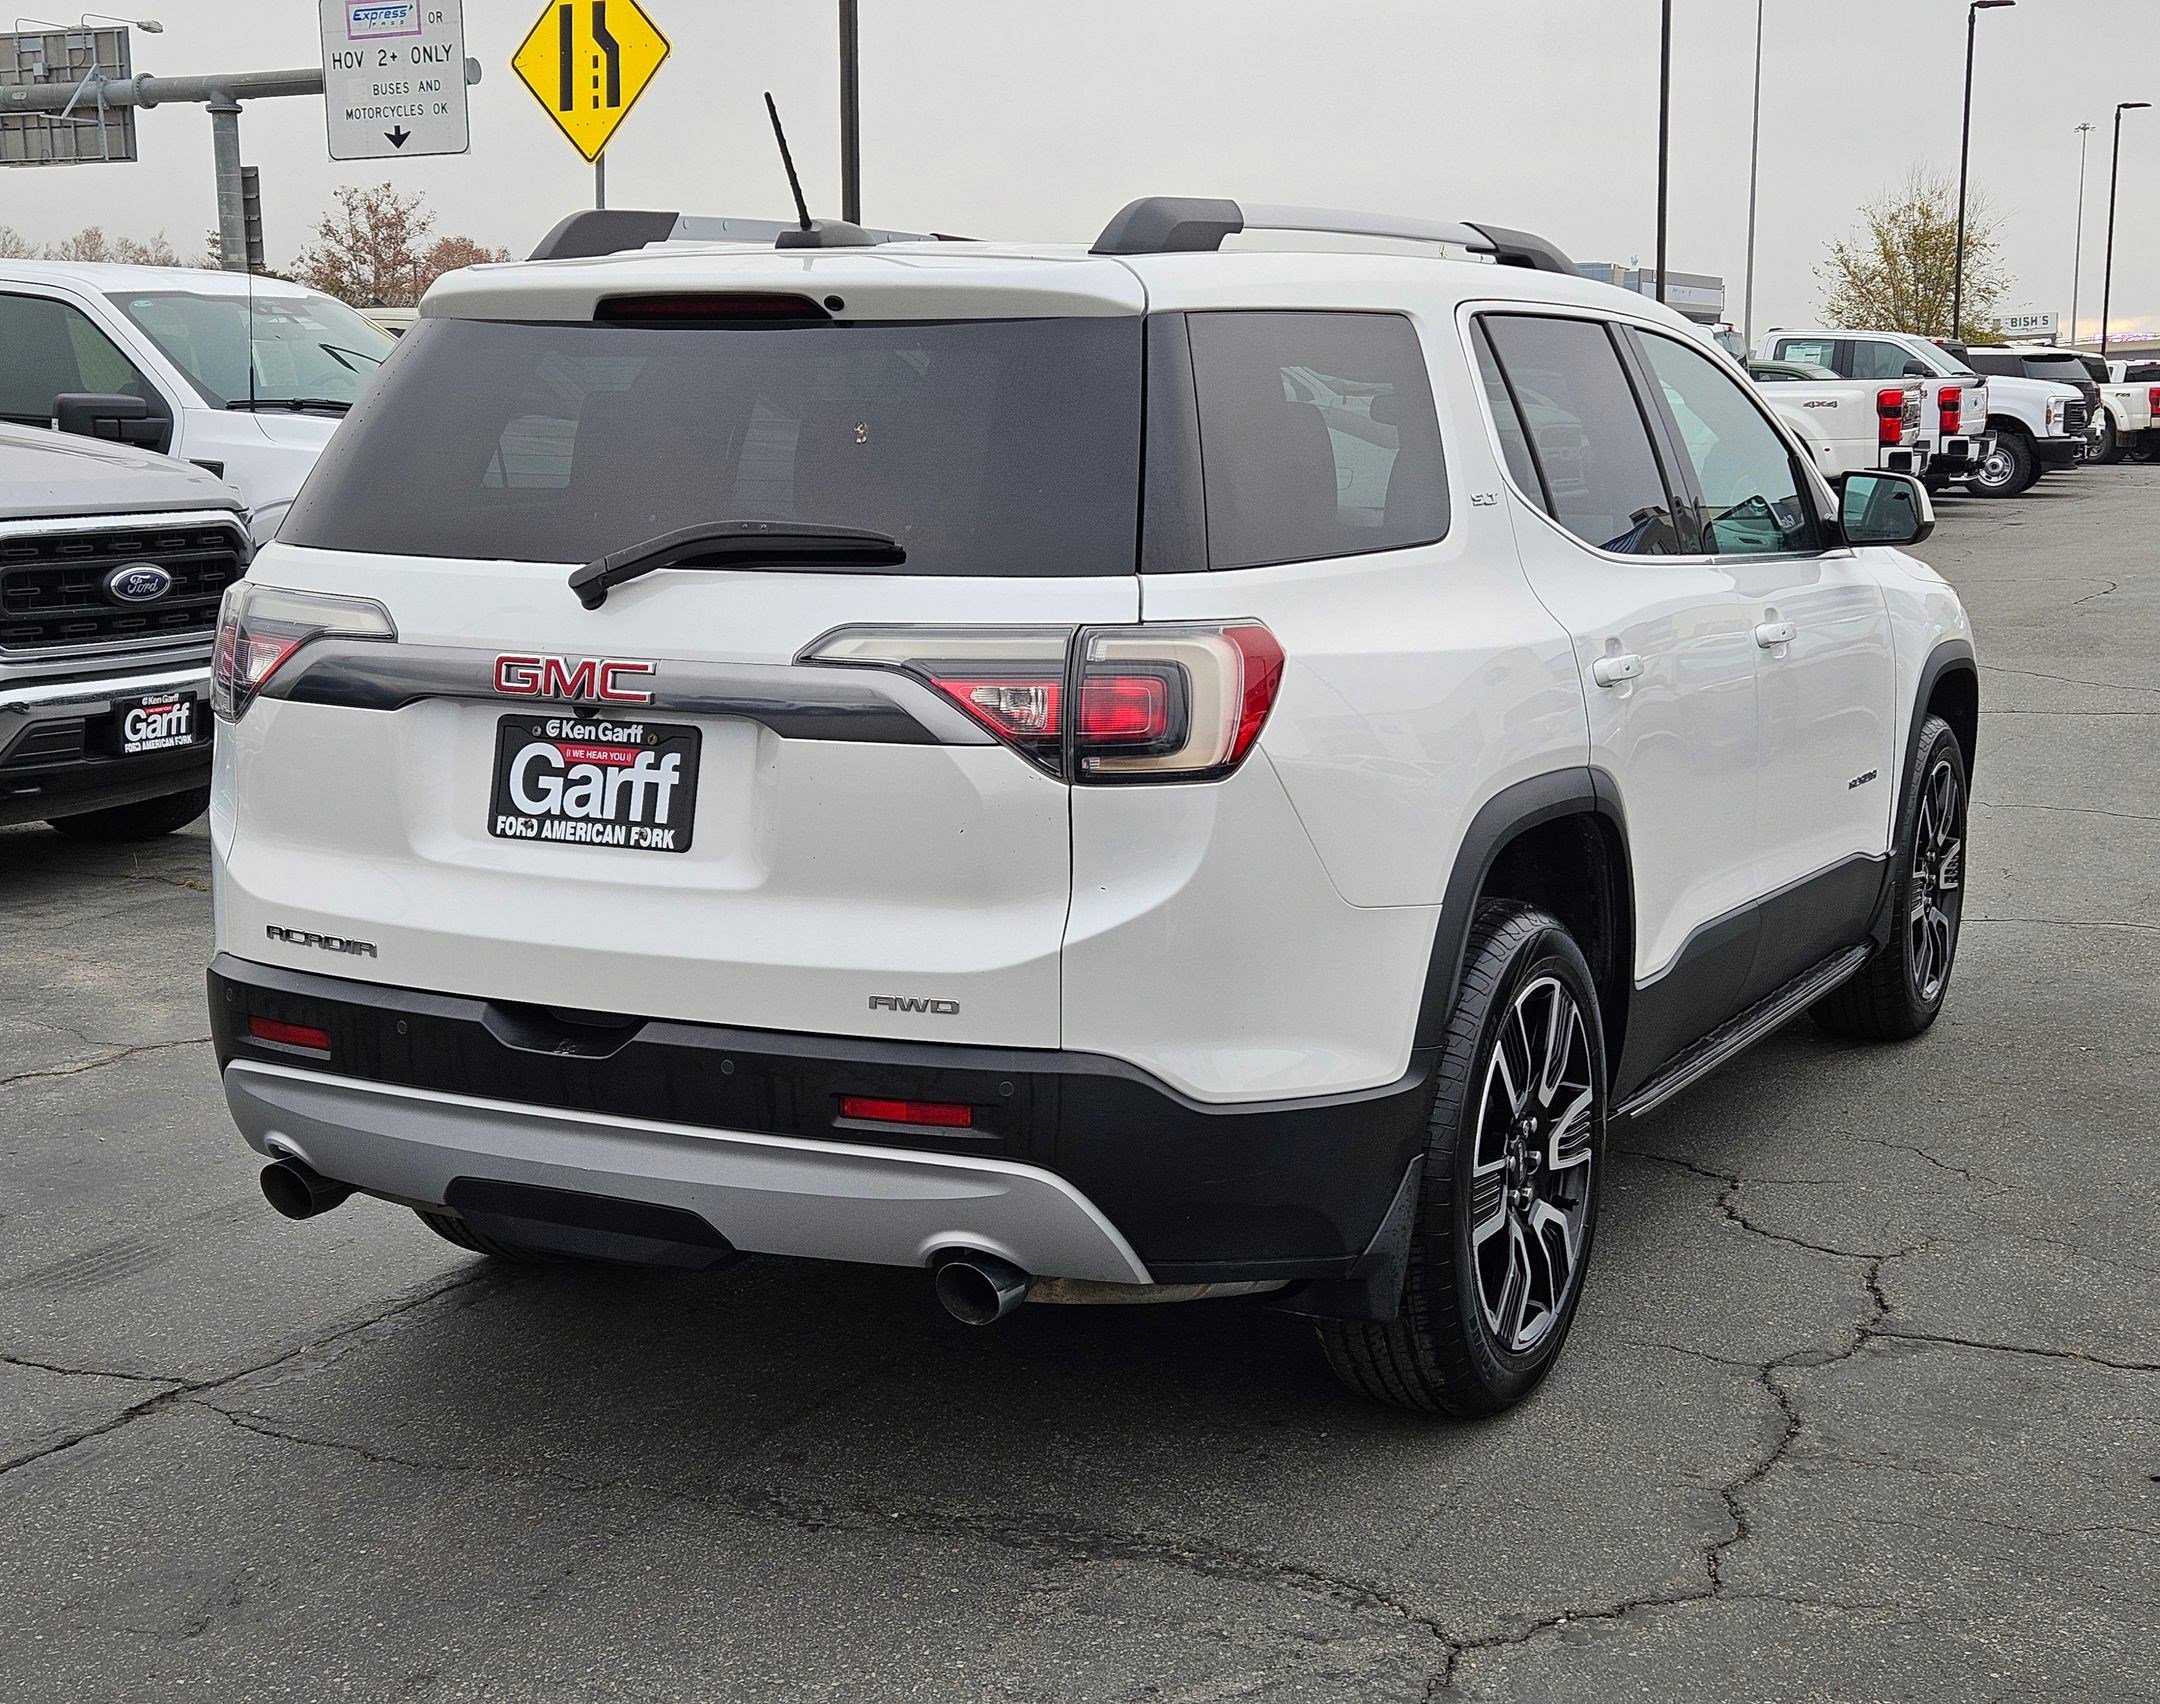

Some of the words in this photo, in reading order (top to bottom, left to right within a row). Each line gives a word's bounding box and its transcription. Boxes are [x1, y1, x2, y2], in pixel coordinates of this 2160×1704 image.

[353, 5, 408, 29] Express
[428, 11, 443, 24] OR
[332, 51, 364, 70] HOV
[377, 49, 398, 67] 2+
[411, 44, 453, 64] ONLY
[373, 82, 410, 96] BUSES
[418, 79, 441, 93] AND
[345, 104, 424, 120] MOTORCYCLES
[433, 102, 448, 115] OK
[2010, 315, 2049, 328] BISH'S
[127, 574, 159, 594] Ford
[493, 653, 657, 705] GMC
[147, 696, 162, 705] Ken
[124, 702, 190, 742] Garff
[561, 720, 596, 740] Ken
[598, 722, 643, 743] Garff
[142, 737, 174, 750] AMERICAN
[572, 750, 585, 759] WE
[586, 751, 608, 760] HEAR
[609, 752, 626, 761] YOU
[509, 742, 681, 824] Garff
[541, 820, 627, 845] AMERICAN
[266, 924, 377, 958] ACADIA
[868, 994, 960, 1015] AWD
